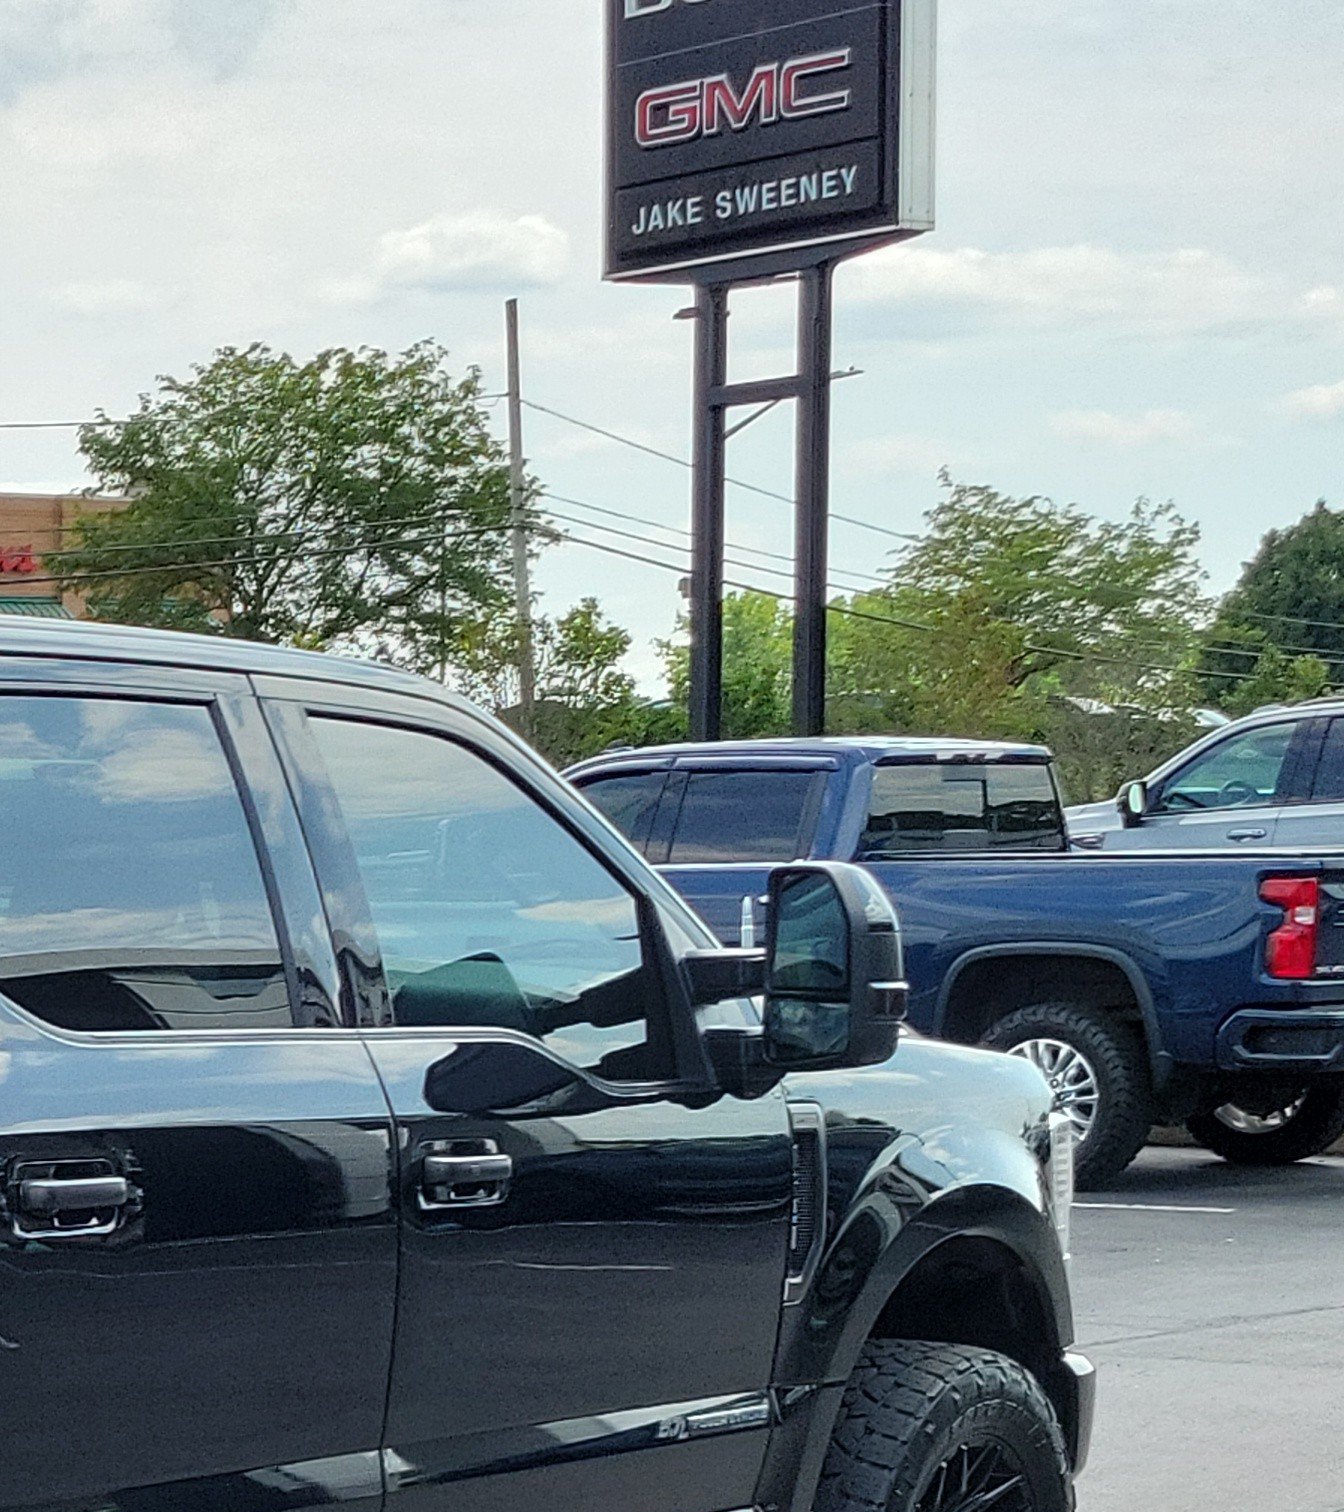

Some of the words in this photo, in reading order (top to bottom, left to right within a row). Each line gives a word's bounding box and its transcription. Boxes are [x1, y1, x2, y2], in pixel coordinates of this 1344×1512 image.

[635, 48, 851, 147] GMC
[631, 197, 703, 235] JAKE
[715, 165, 858, 219] SWEENEY
